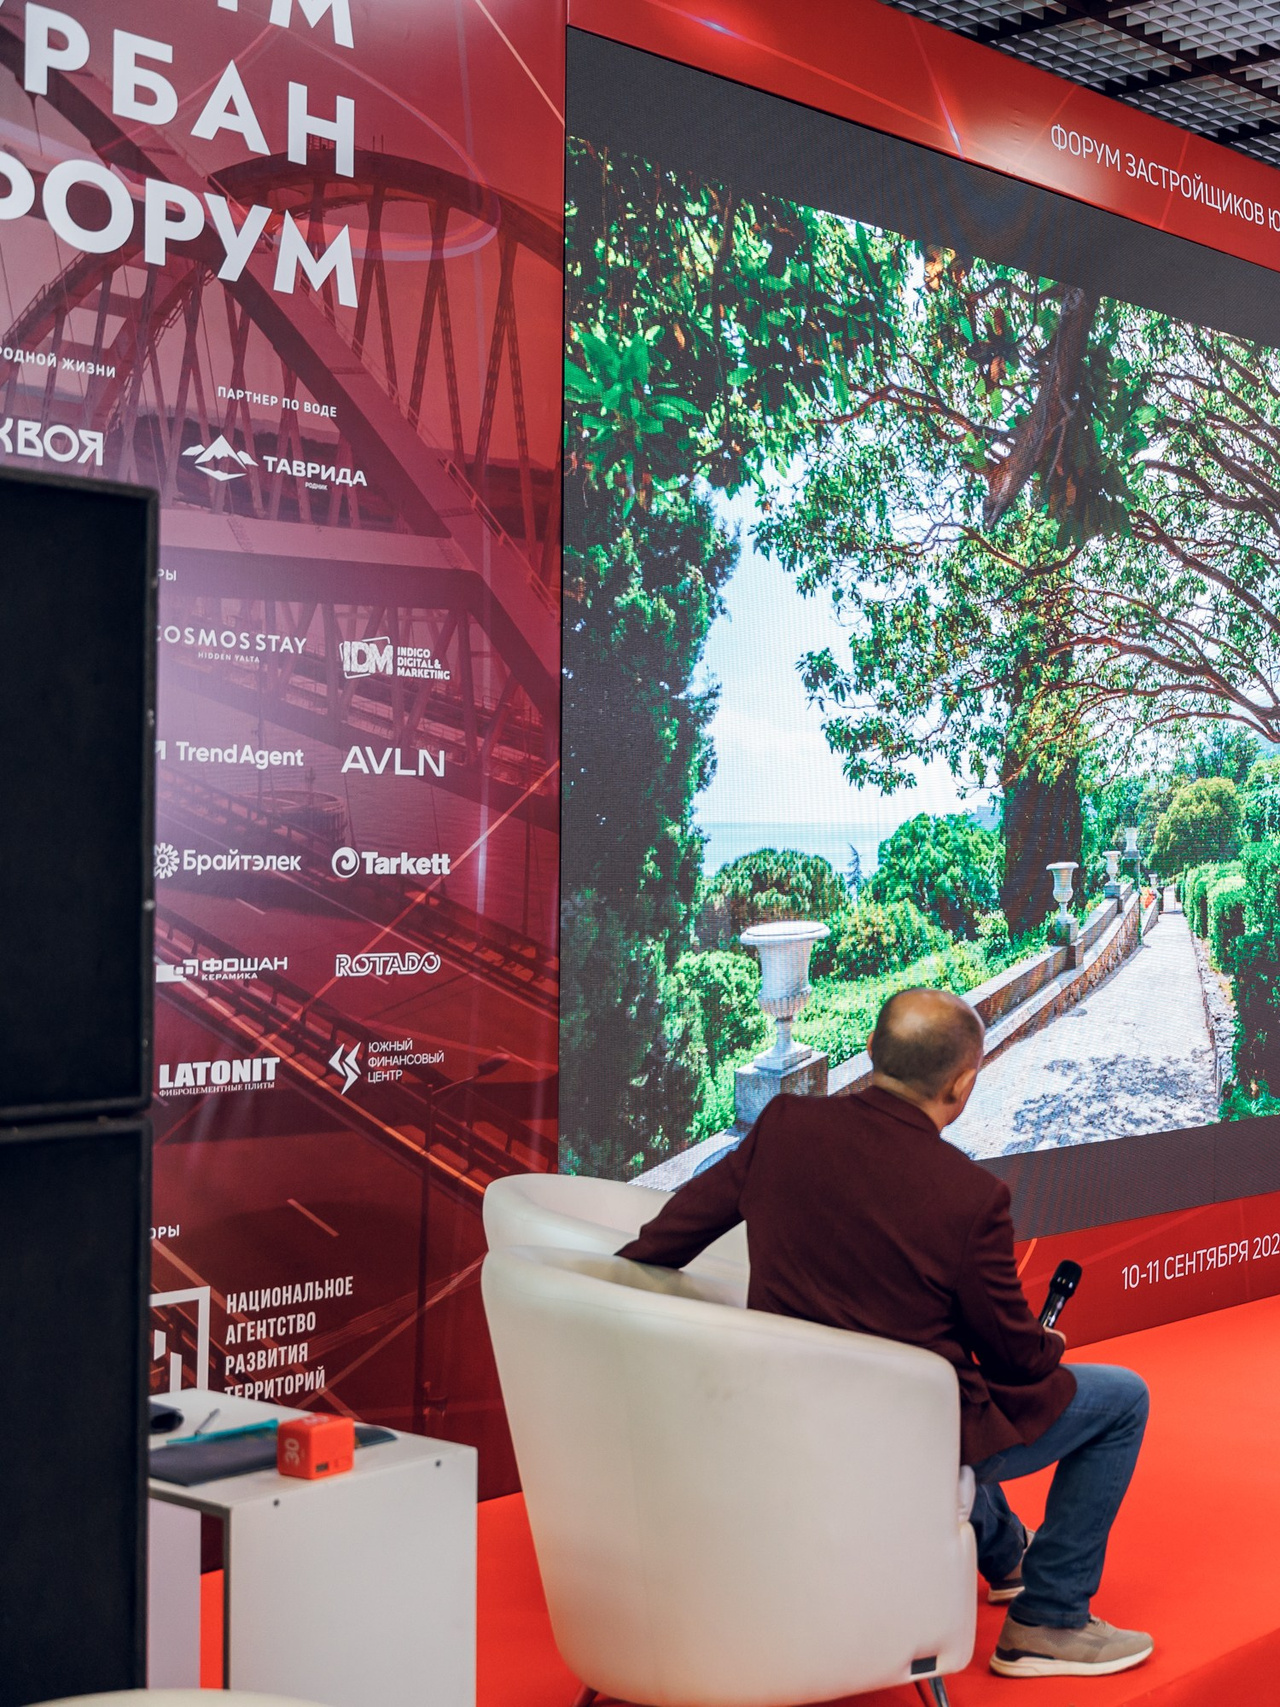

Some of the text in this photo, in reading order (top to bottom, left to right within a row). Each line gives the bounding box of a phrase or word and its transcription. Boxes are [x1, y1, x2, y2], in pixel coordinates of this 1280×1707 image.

[0, 0, 355, 178] РБАН
[1050, 123, 1121, 172] ФОРУМ
[1125, 152, 1265, 226] ЗАСТРОЙЩИКОВ
[0, 346, 116, 378] ОДНОЙ ЖИЗНИ
[218, 386, 338, 418] ПАРТНЕР ПО ВОДЕ
[263, 455, 368, 487] ТАВРИДА
[157, 625, 307, 654] OSMOS STAY
[397, 646, 431, 658] INDIGO
[198, 651, 260, 663] HIDDEN YALTA
[343, 641, 394, 676] IDM
[397, 667, 451, 681] MARKETING
[176, 741, 304, 770] TrendAgent
[341, 745, 445, 777] AVLN
[183, 849, 302, 875] Брайтэлек
[362, 851, 451, 875] Tarkett
[202, 956, 288, 972] ФОШАН
[202, 972, 258, 981] КЕРАМИКА
[336, 951, 441, 977] ROTADO
[368, 1038, 413, 1053] ЮЖНЫЙ
[368, 1050, 444, 1069] ФИНАНСОВЫЙ
[159, 1057, 280, 1088] LATONIT
[368, 1069, 403, 1083] ЦЕНТР
[159, 1081, 275, 1097] ФИБРОЦЕМЕНТНЫЕ ПЛИТЫ
[1121, 1259, 1160, 1290] 10-11
[1164, 1239, 1249, 1281] СЕНТЯБРЯ
[226, 1275, 354, 1315] НАЦИОНАЛЬНОЕ
[225, 1311, 317, 1345] АГЕНТСТВО
[224, 1342, 309, 1376] РАЗВИТИЯ
